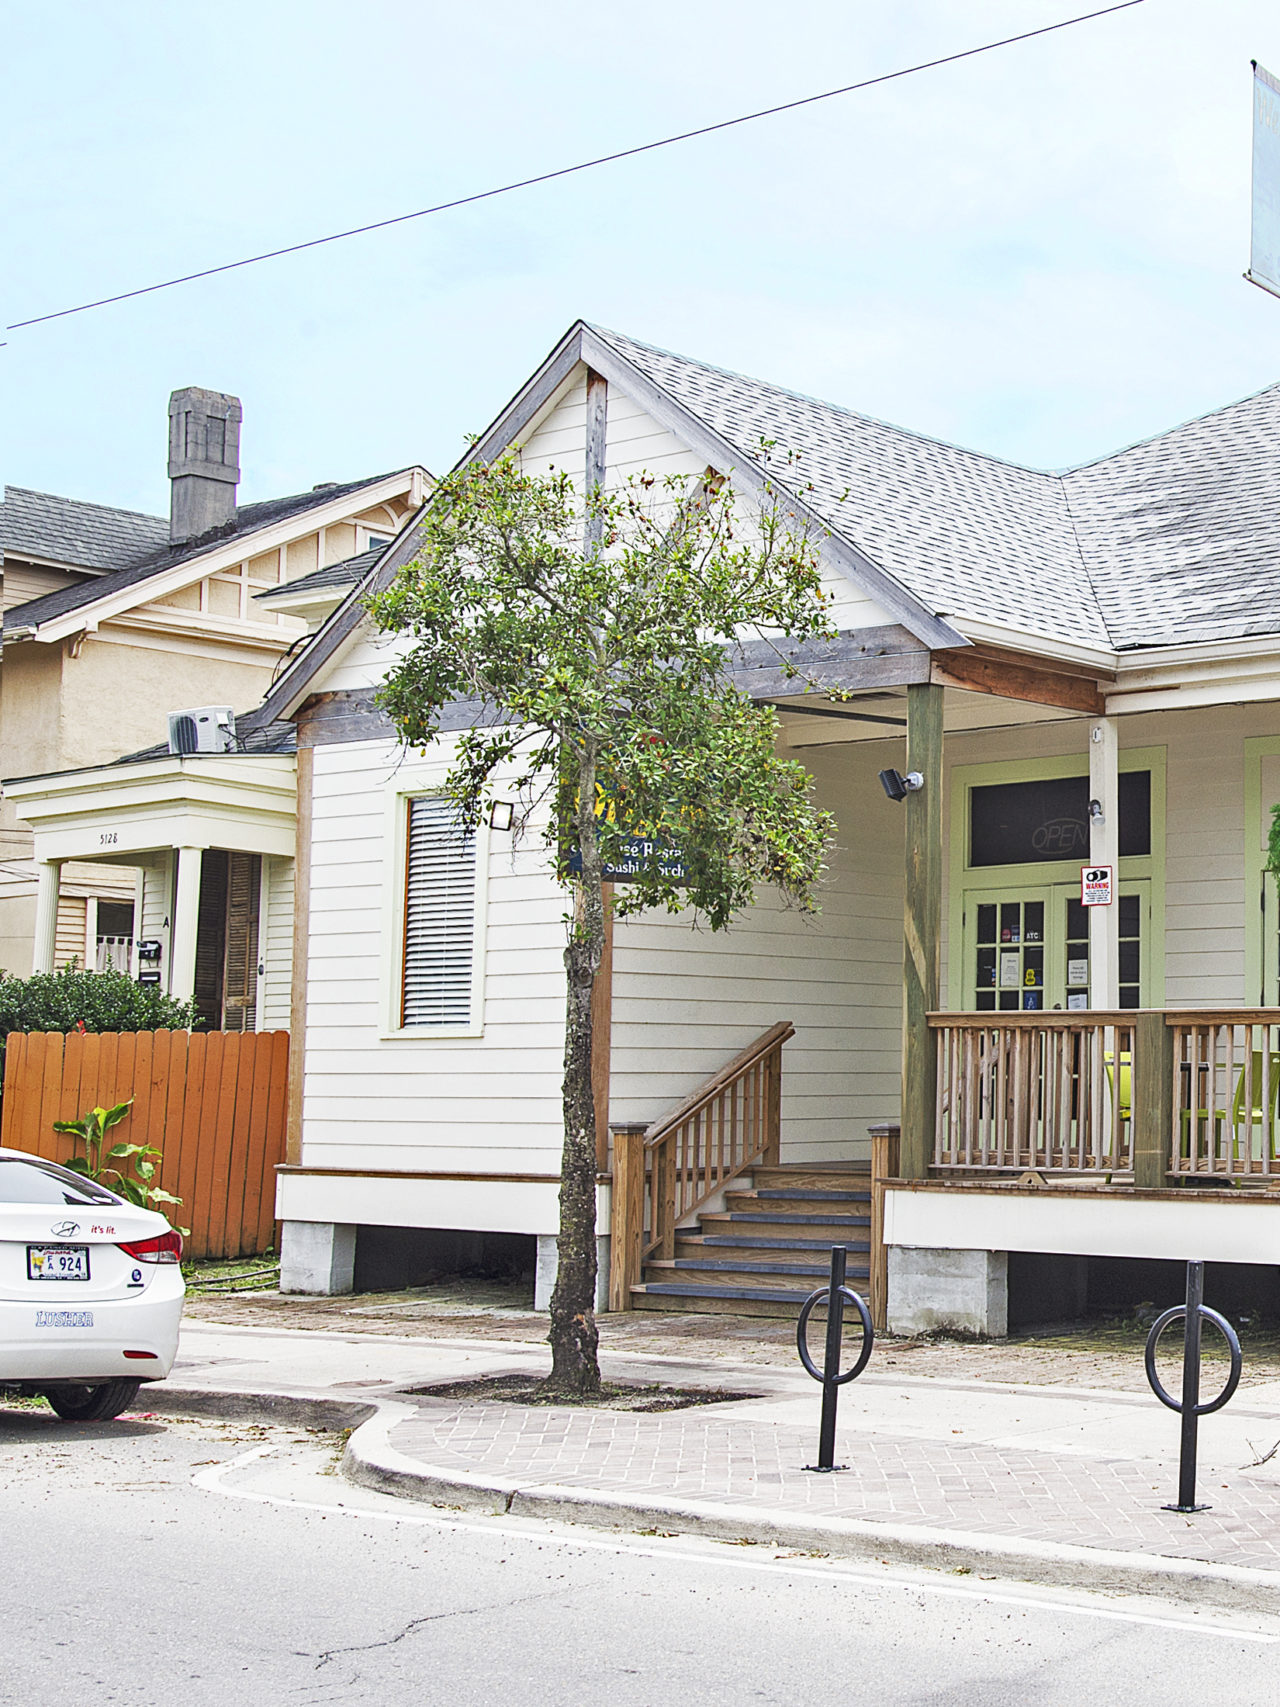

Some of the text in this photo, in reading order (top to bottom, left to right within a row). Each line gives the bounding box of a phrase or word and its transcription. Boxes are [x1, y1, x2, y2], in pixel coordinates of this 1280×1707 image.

[100, 832, 118, 844] 5128
[1032, 824, 1089, 848] OPEN
[606, 860, 639, 874] Sushi
[162, 916, 170, 928] A
[91, 1225, 104, 1234] it's
[60, 1256, 81, 1271] 924
[35, 1311, 94, 1328] LUSHER
